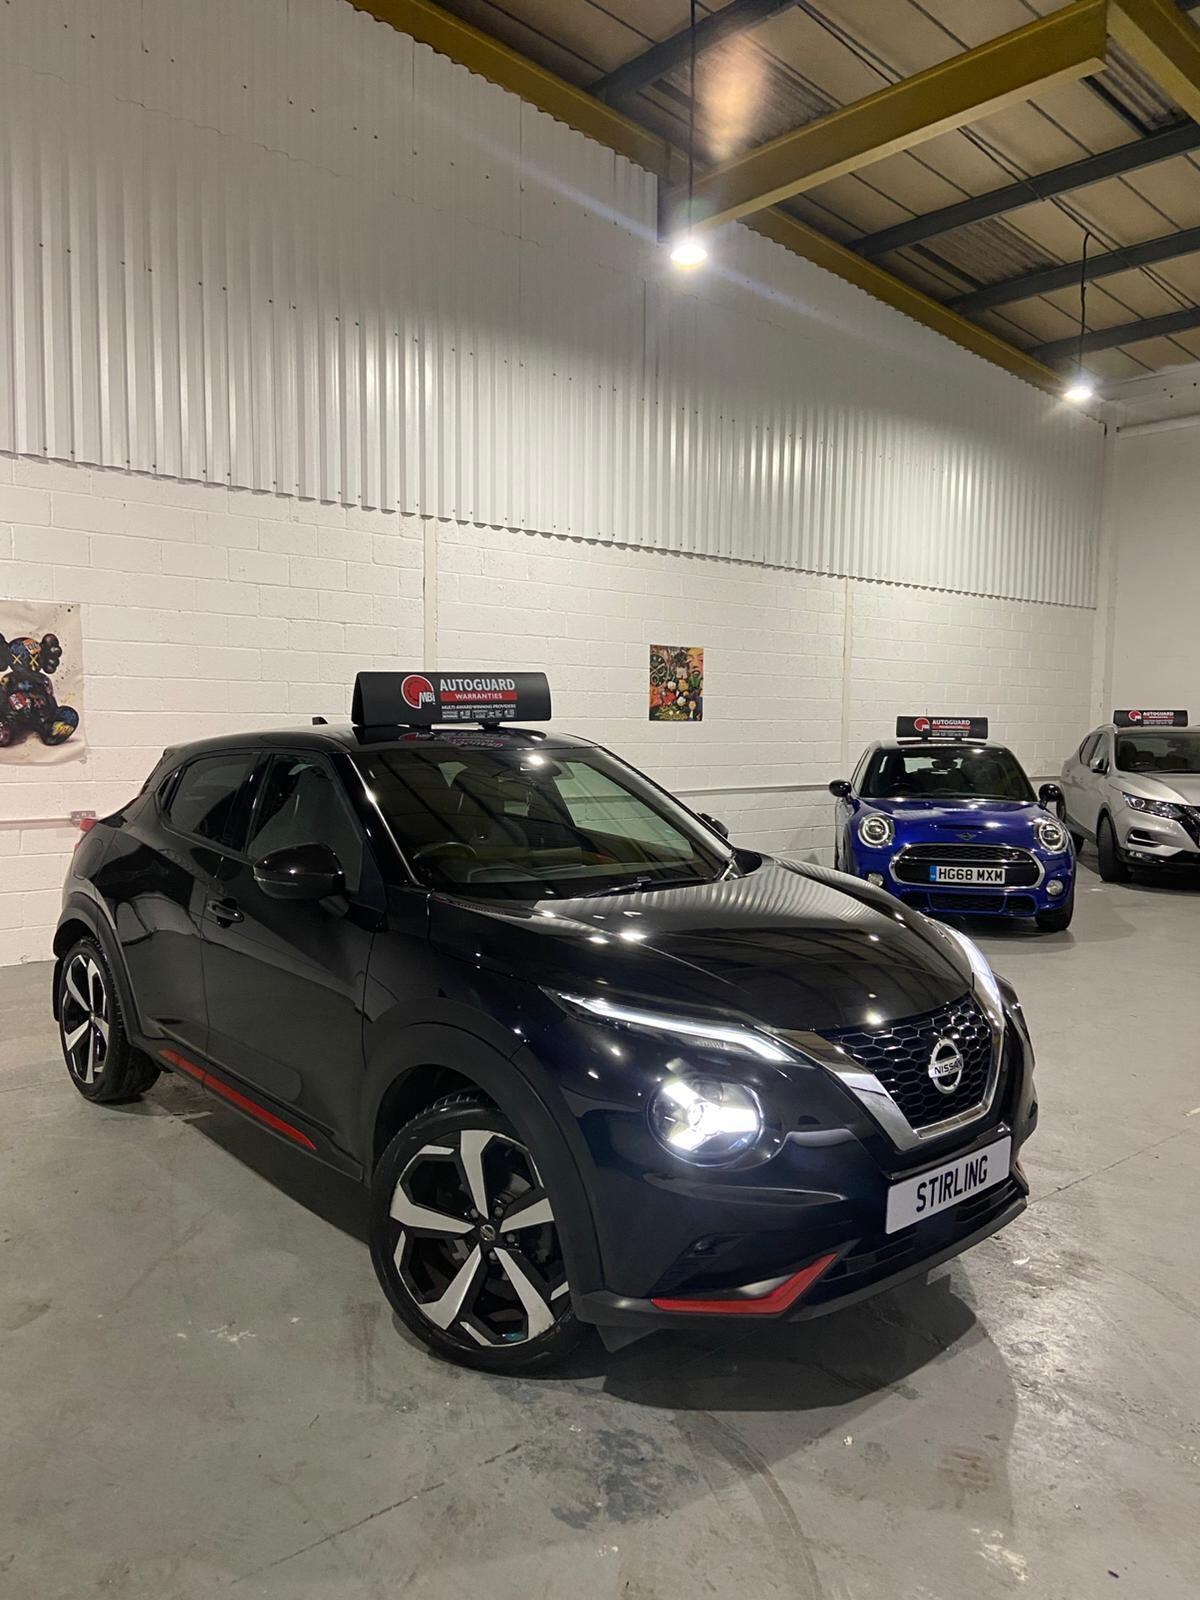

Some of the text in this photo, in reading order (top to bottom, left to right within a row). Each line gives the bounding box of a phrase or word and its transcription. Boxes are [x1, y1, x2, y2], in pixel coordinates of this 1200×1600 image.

[440, 678, 515, 691] AUTOGUARD
[938, 868, 1003, 881] HG68 MXM
[916, 1155, 988, 1213] STIRLING
